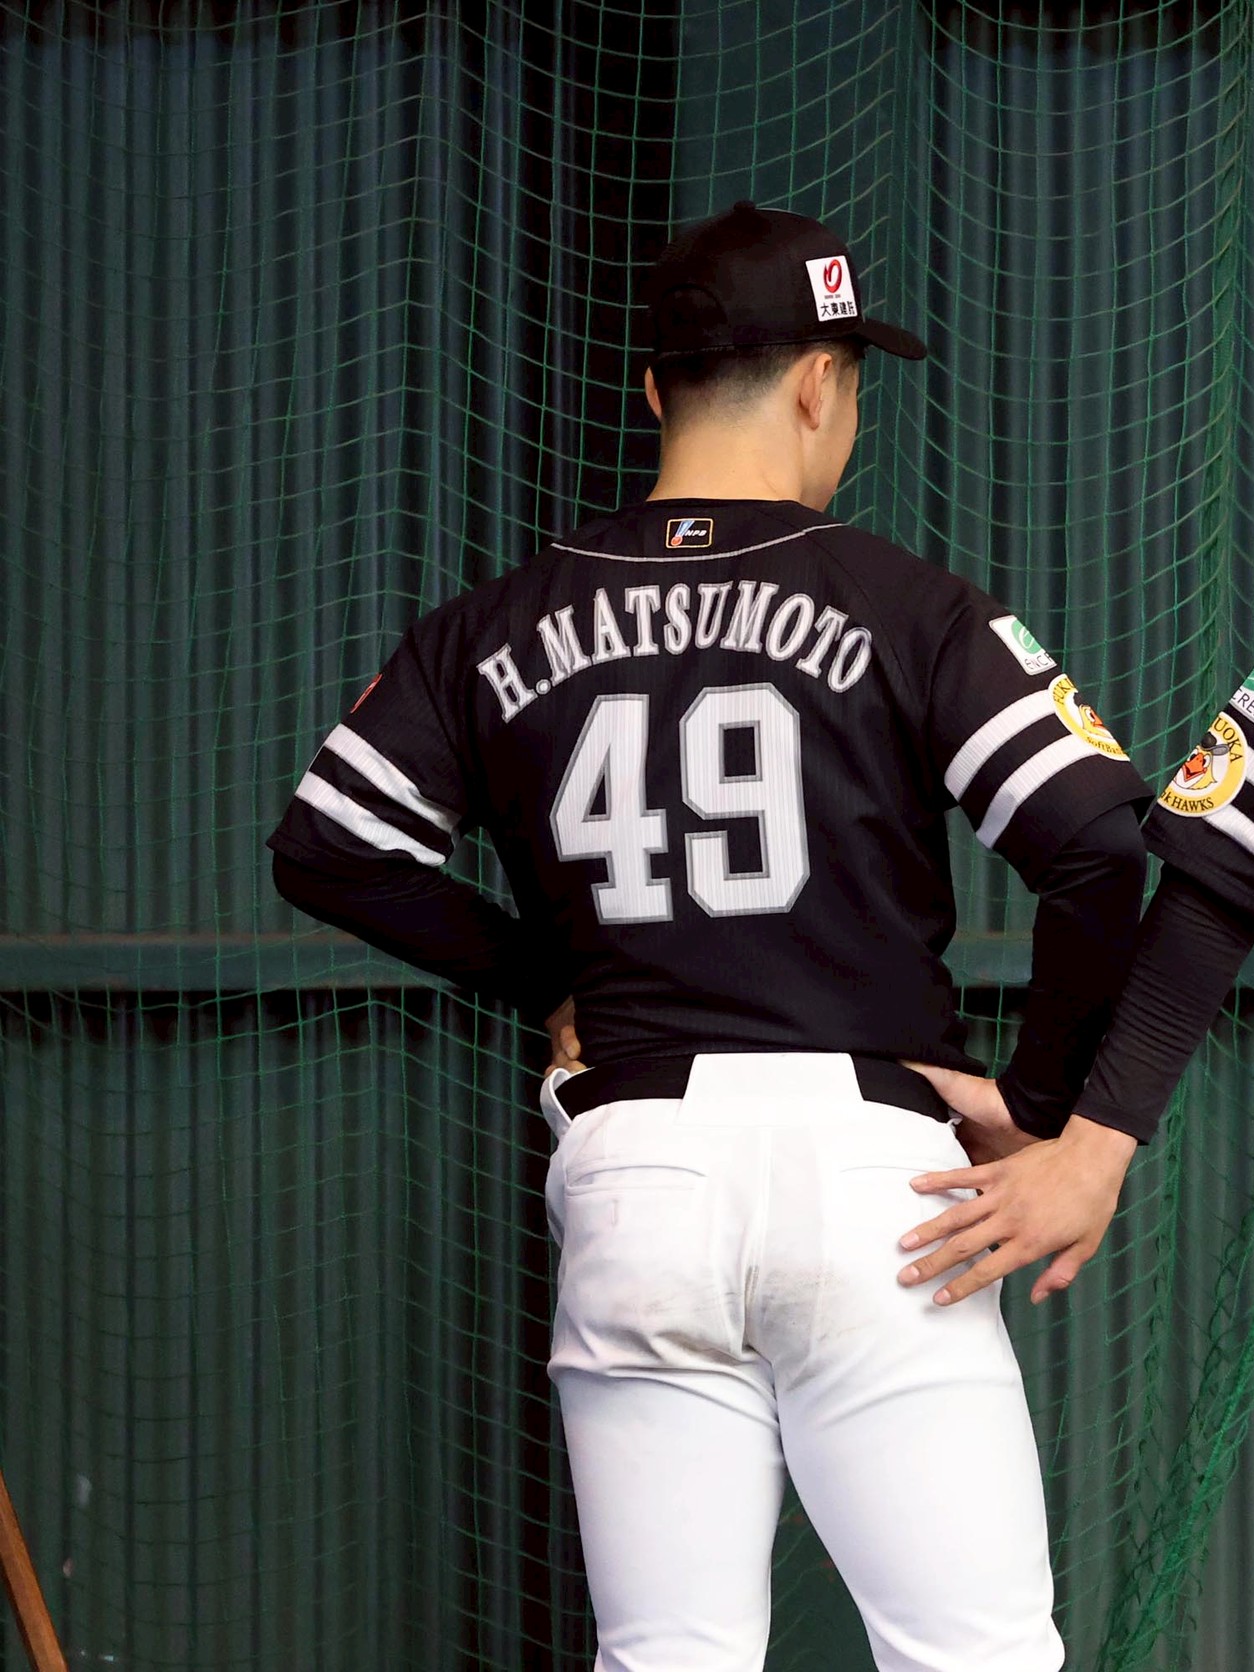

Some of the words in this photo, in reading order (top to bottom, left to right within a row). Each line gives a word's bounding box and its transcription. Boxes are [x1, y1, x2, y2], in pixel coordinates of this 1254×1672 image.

[476, 580, 873, 723] H.MATSUMOTO
[549, 682, 811, 925] 49
[1171, 797, 1214, 811] HAWKS
